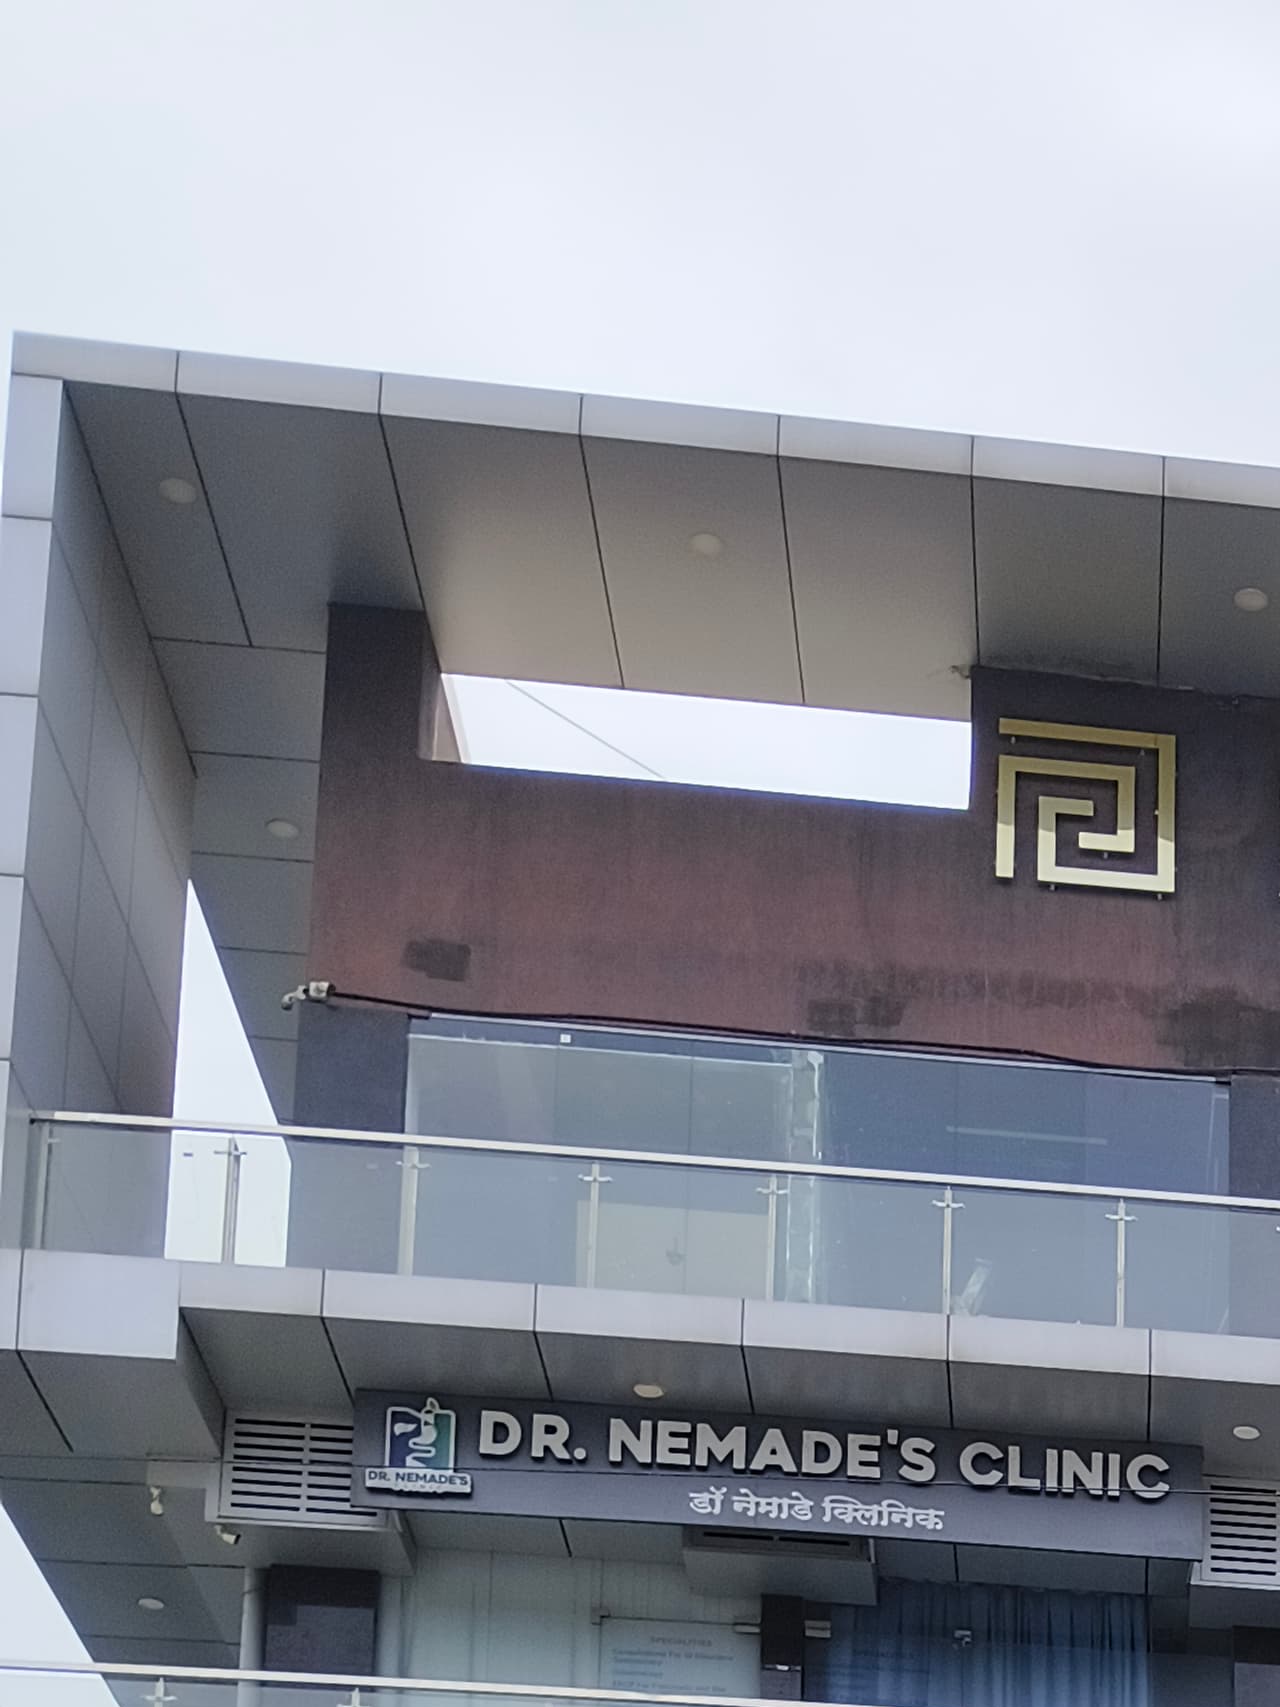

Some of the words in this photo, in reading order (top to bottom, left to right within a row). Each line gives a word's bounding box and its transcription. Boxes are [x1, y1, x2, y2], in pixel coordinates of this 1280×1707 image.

[479, 1409, 588, 1461] DR.
[608, 1417, 937, 1483] NEMADE'S
[958, 1441, 1171, 1500] CLINIC
[367, 1470, 391, 1482] DR.
[394, 1472, 469, 1487] NEMADE'S
[687, 1486, 729, 1515] डॉ
[732, 1488, 814, 1521] नेमाडे
[822, 1495, 946, 1530] क्लिनिक
